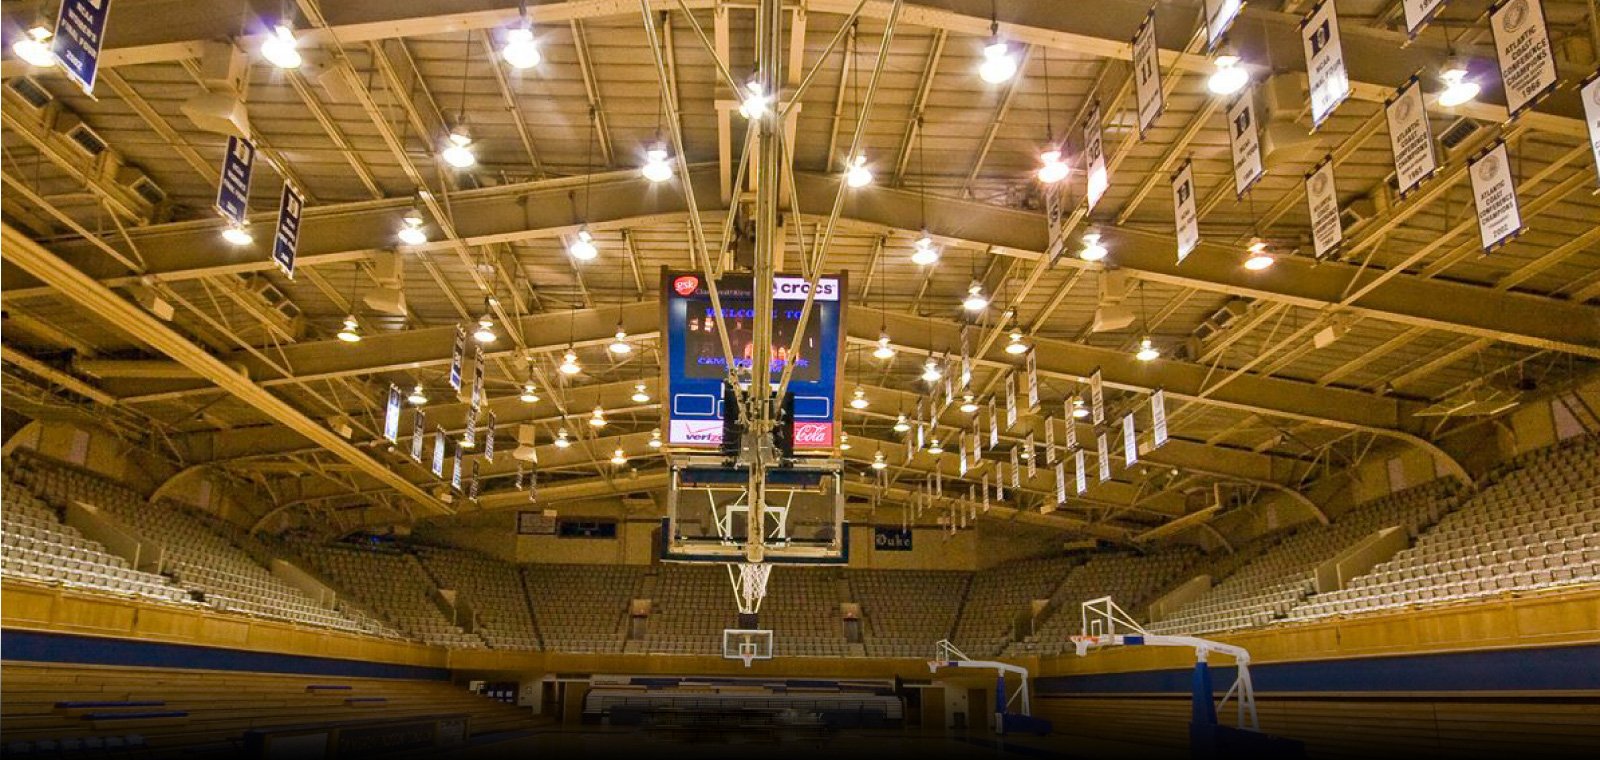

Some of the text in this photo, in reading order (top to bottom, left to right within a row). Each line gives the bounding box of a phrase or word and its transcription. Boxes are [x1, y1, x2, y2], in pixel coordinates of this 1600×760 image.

[1505, 25, 1536, 55] ATLANTIC
[1511, 38, 1532, 61] COAST
[1141, 56, 1152, 86] 11
[1503, 38, 1546, 79] CONFERENCE
[1506, 49, 1547, 87] CHAMPIONS
[1397, 119, 1420, 143] ATLANTIC
[1400, 130, 1417, 148] COAST
[1395, 131, 1428, 163] CONFERENCE
[1398, 141, 1428, 169] CHAMPIONS
[1481, 179, 1506, 201] ATLANTIC
[1485, 190, 1503, 206] COAST
[1479, 192, 1513, 219] CONFERENCE
[1481, 201, 1514, 226] CHAMPIONS
[781, 282, 832, 295] crocs
[876, 534, 911, 547] Duke
